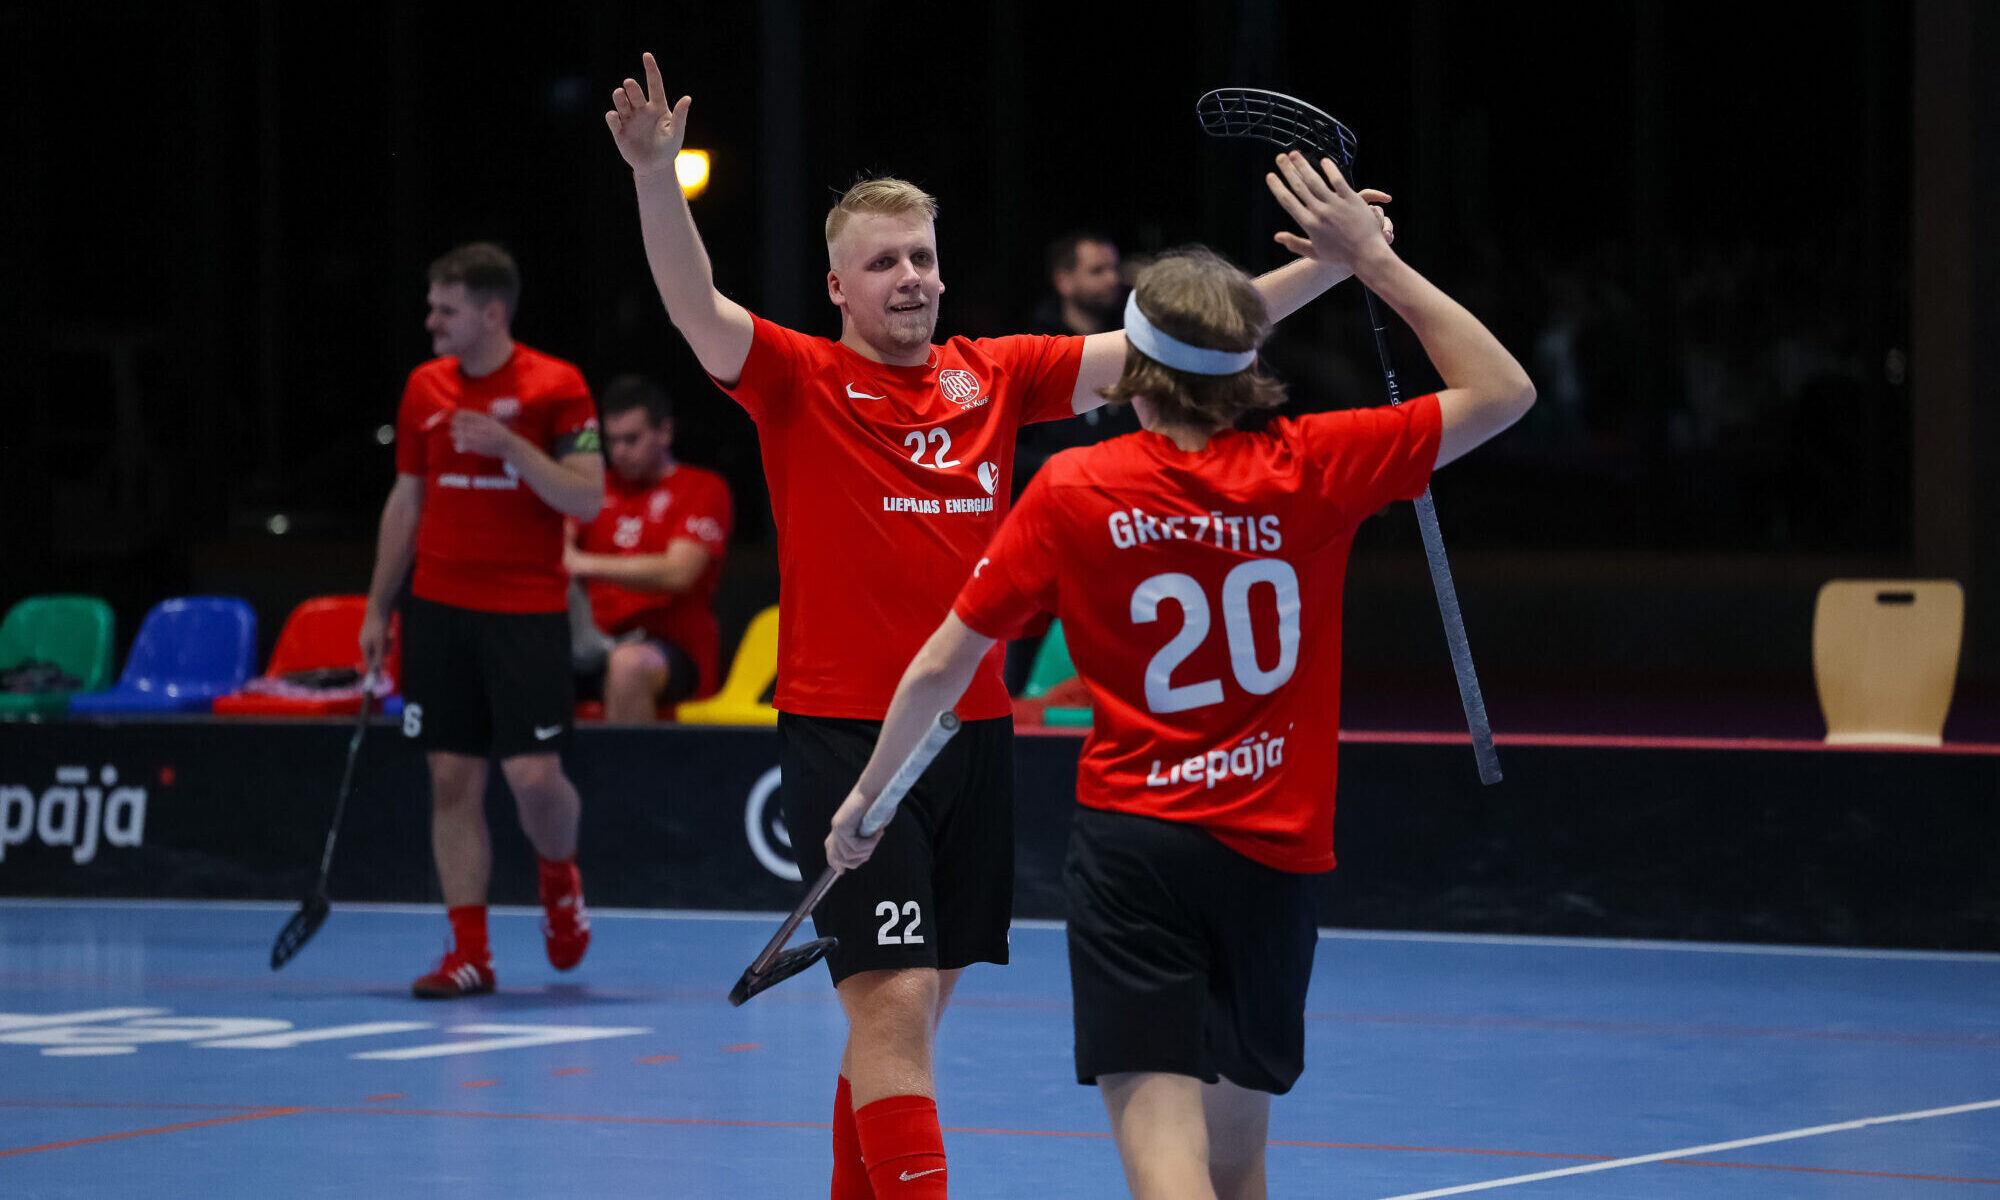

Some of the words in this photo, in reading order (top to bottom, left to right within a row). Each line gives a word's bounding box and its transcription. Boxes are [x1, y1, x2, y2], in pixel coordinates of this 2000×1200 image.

[904, 427, 961, 469] 22
[883, 496, 940, 514] LIEPĀJAS
[1130, 558, 1301, 714] 20
[1146, 731, 1285, 789] Liepāja
[875, 900, 924, 945] 22
